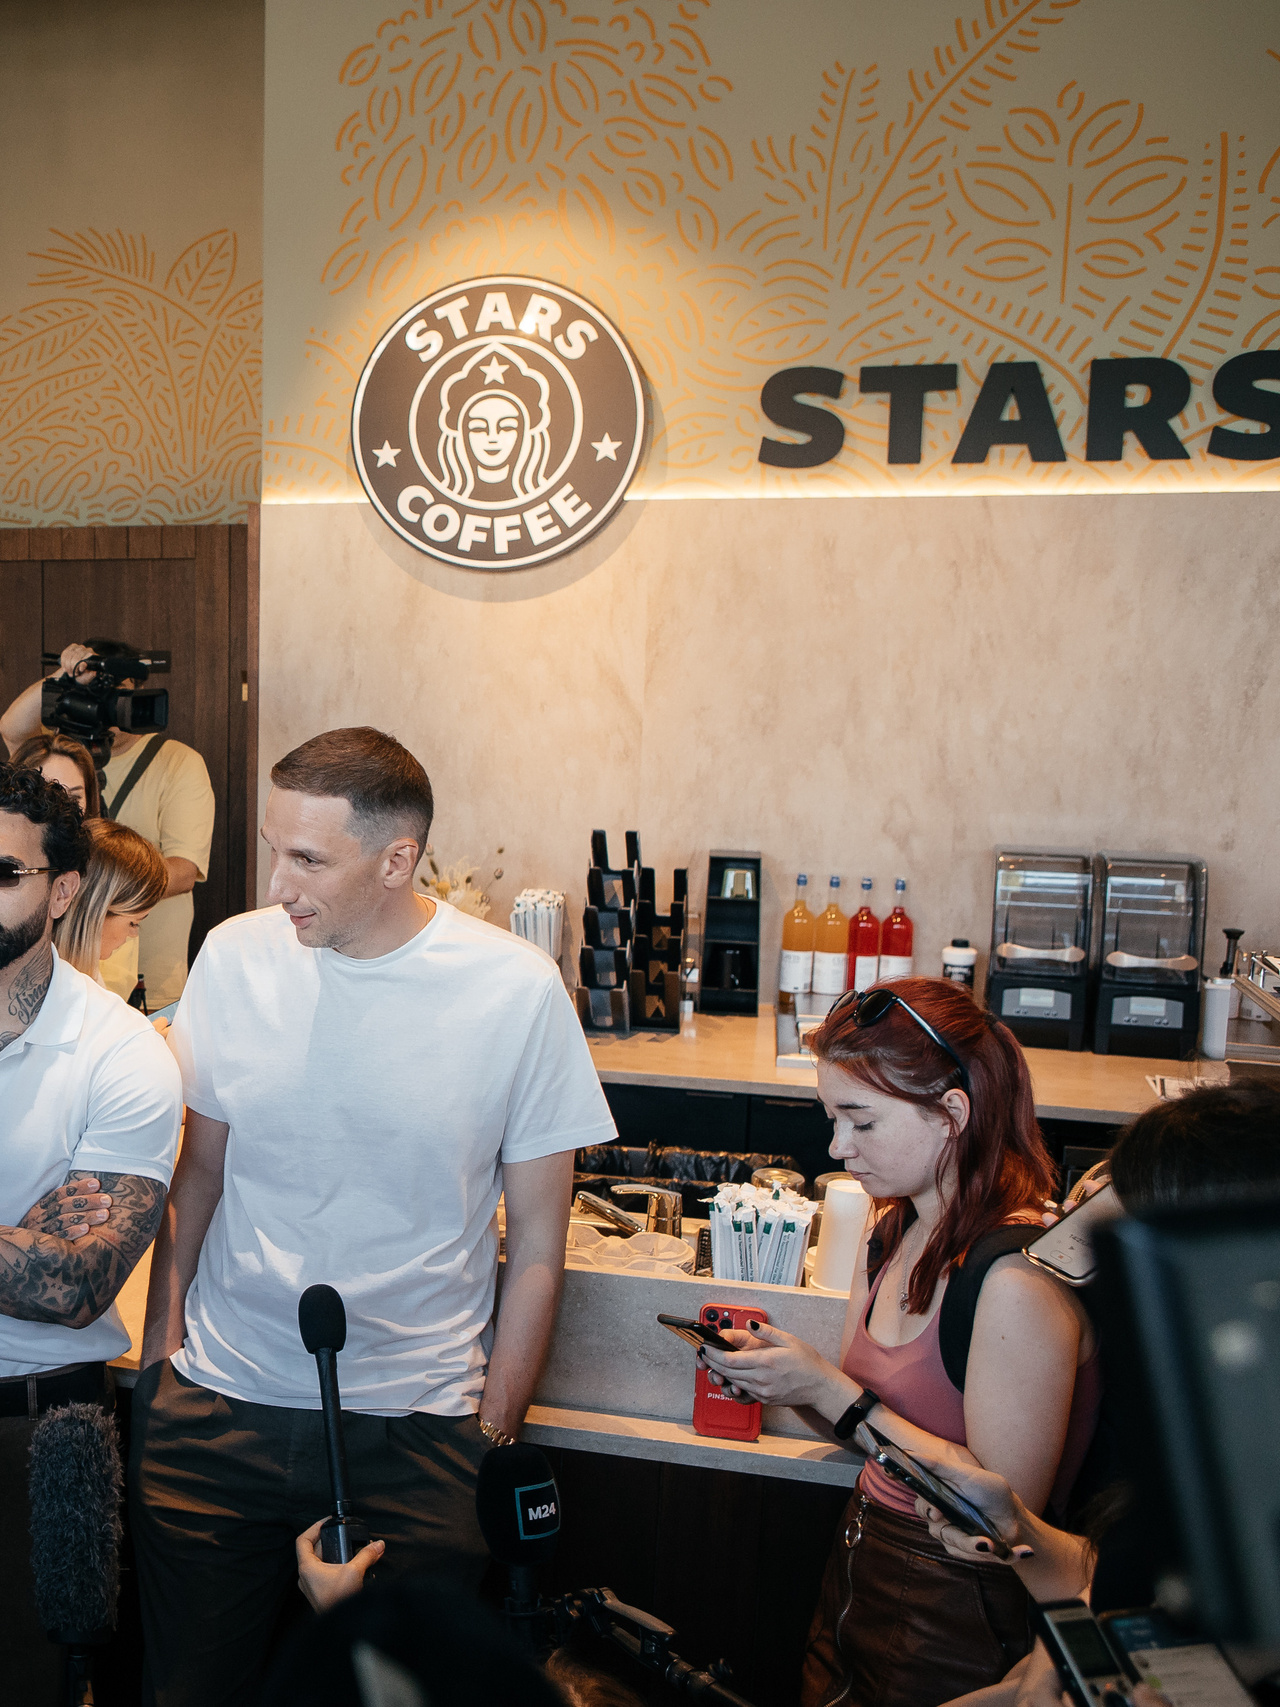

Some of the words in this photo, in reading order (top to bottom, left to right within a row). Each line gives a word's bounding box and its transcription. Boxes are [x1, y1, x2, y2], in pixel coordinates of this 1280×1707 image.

[405, 292, 599, 363] STARS
[758, 350, 1280, 469] STARS
[397, 483, 593, 554] COFFEE
[528, 1502, 556, 1520] M24
